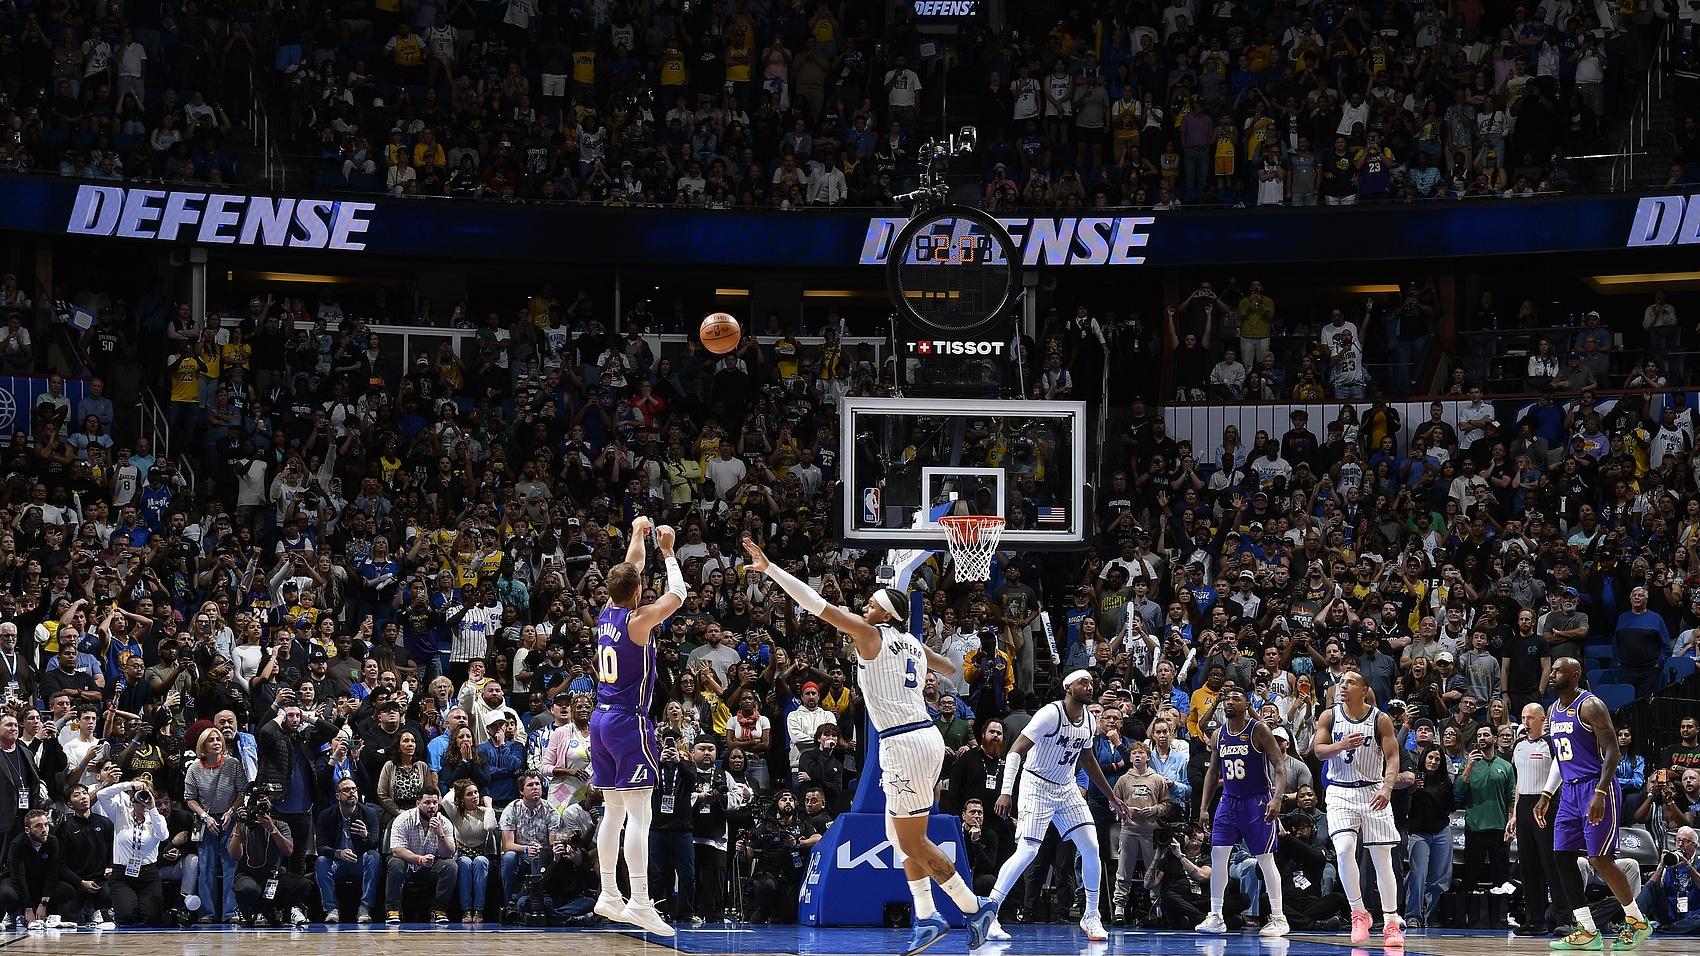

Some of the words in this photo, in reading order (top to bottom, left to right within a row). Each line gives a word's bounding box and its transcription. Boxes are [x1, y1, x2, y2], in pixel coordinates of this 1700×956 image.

[66, 184, 377, 251] DEFENSE
[932, 341, 1005, 355] TISSOT
[123, 481, 131, 491] 8
[904, 658, 918, 688] 5
[1218, 743, 1249, 758] LAKERS
[1343, 749, 1357, 764] 3
[1225, 758, 1246, 781] 36
